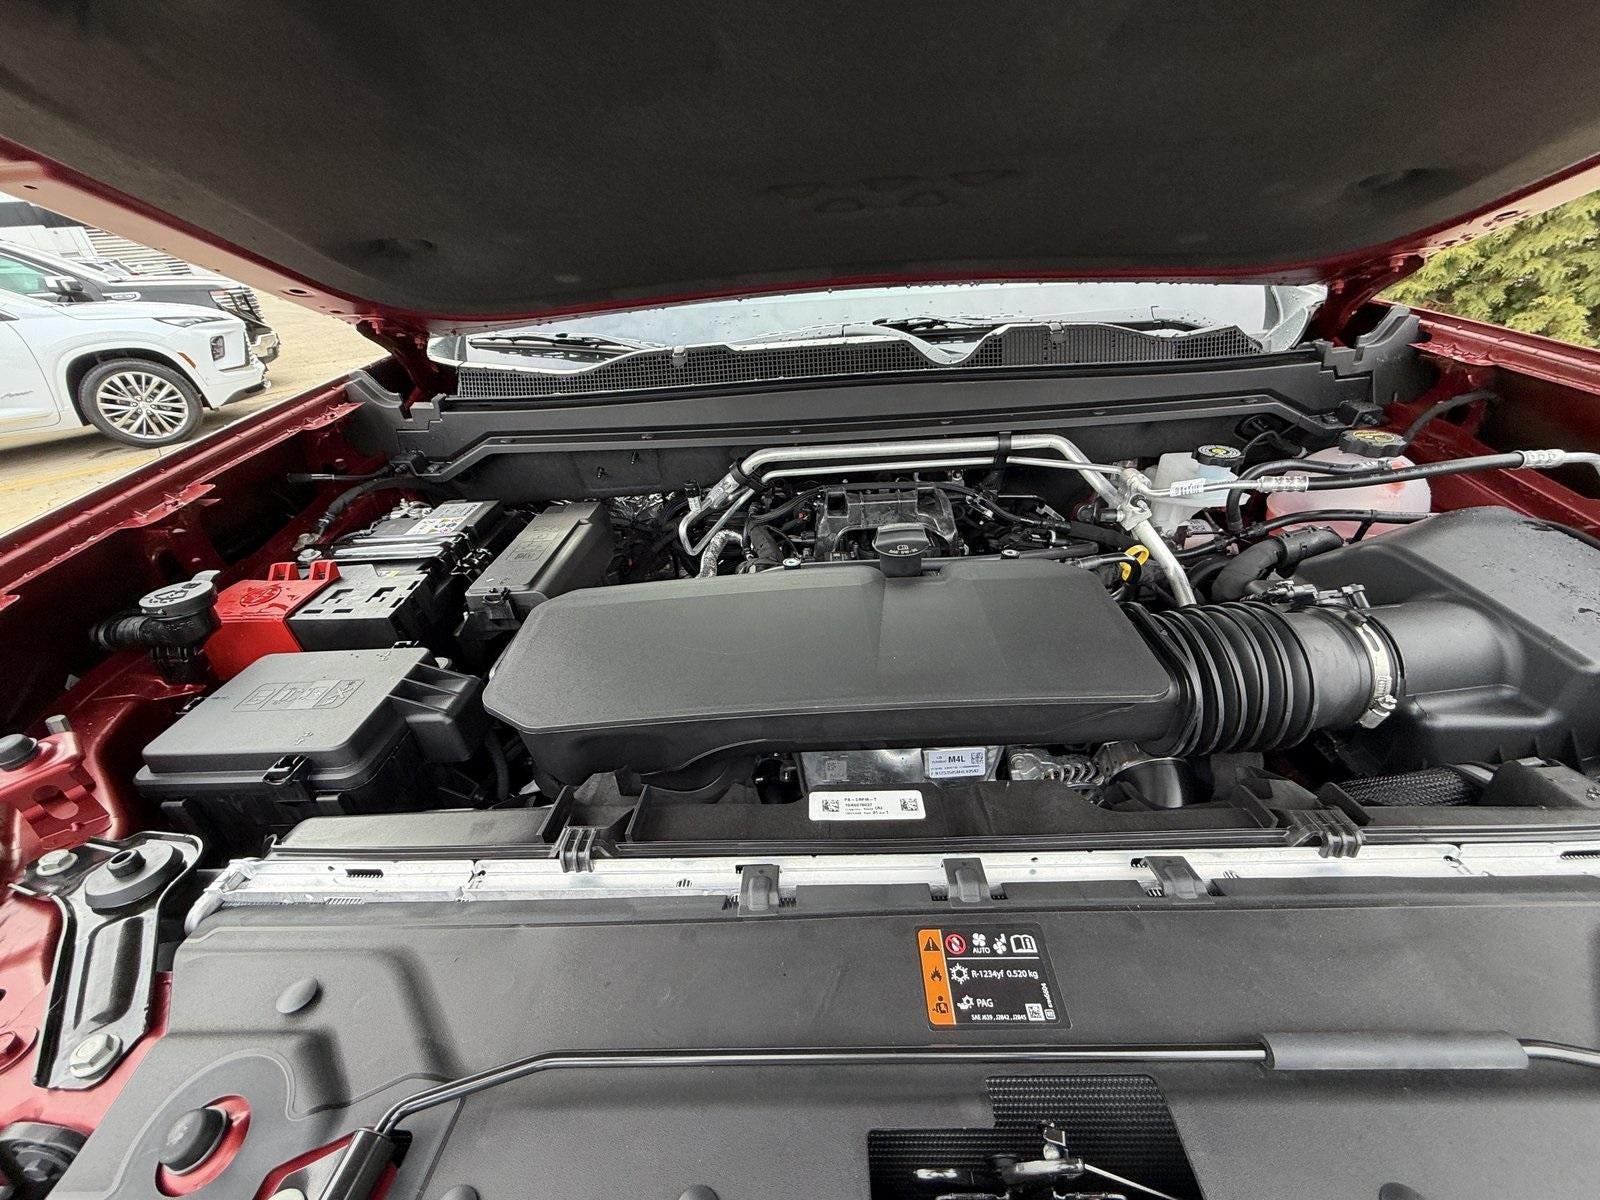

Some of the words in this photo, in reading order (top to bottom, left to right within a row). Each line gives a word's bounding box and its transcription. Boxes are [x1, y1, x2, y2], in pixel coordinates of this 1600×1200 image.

[948, 755, 965, 763] M4L
[971, 969, 1004, 980] R-1234yf
[1006, 969, 1027, 978] 0.520
[1028, 969, 1039, 979] kg
[976, 998, 993, 1008] PAG
